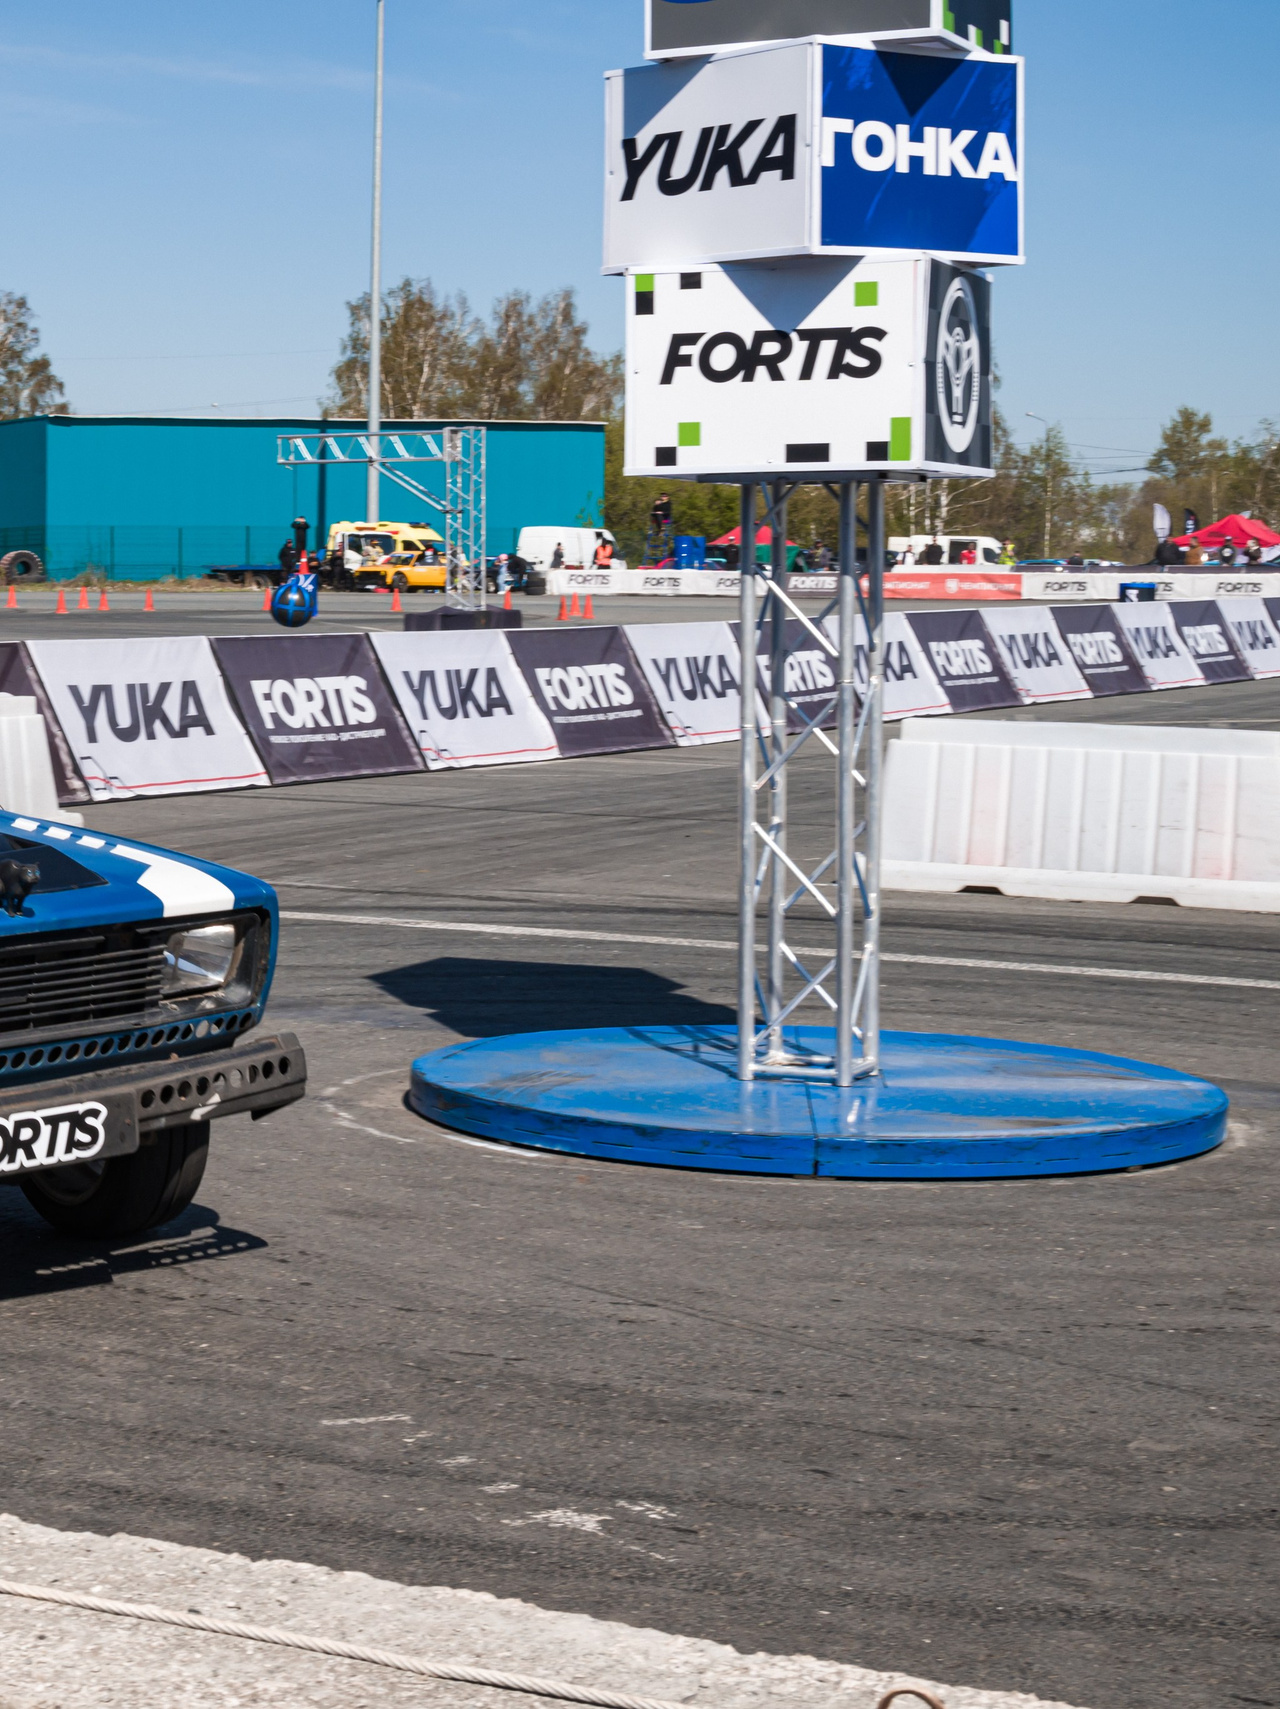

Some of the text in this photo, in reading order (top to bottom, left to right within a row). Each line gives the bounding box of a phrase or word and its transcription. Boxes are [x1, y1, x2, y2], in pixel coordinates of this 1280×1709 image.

[619, 113, 797, 203] YUKA
[821, 117, 1018, 182] ГОНКА
[660, 326, 888, 386] FORTIS
[567, 574, 612, 587] FORTIS
[642, 576, 682, 588] FORTIS
[788, 576, 838, 589] FORTIS
[1043, 581, 1087, 592] FORTIS
[1216, 582, 1263, 593] FORTIS
[927, 639, 994, 677] FORTIS
[998, 631, 1064, 670] YUKA
[1066, 631, 1124, 666] FORTIS
[534, 662, 635, 711] FORTIS
[650, 654, 741, 702] YUKA
[756, 650, 836, 693] FRTIS
[67, 679, 216, 744] YUKA
[250, 675, 378, 730] FORTIS
[402, 667, 514, 721] YUKA
